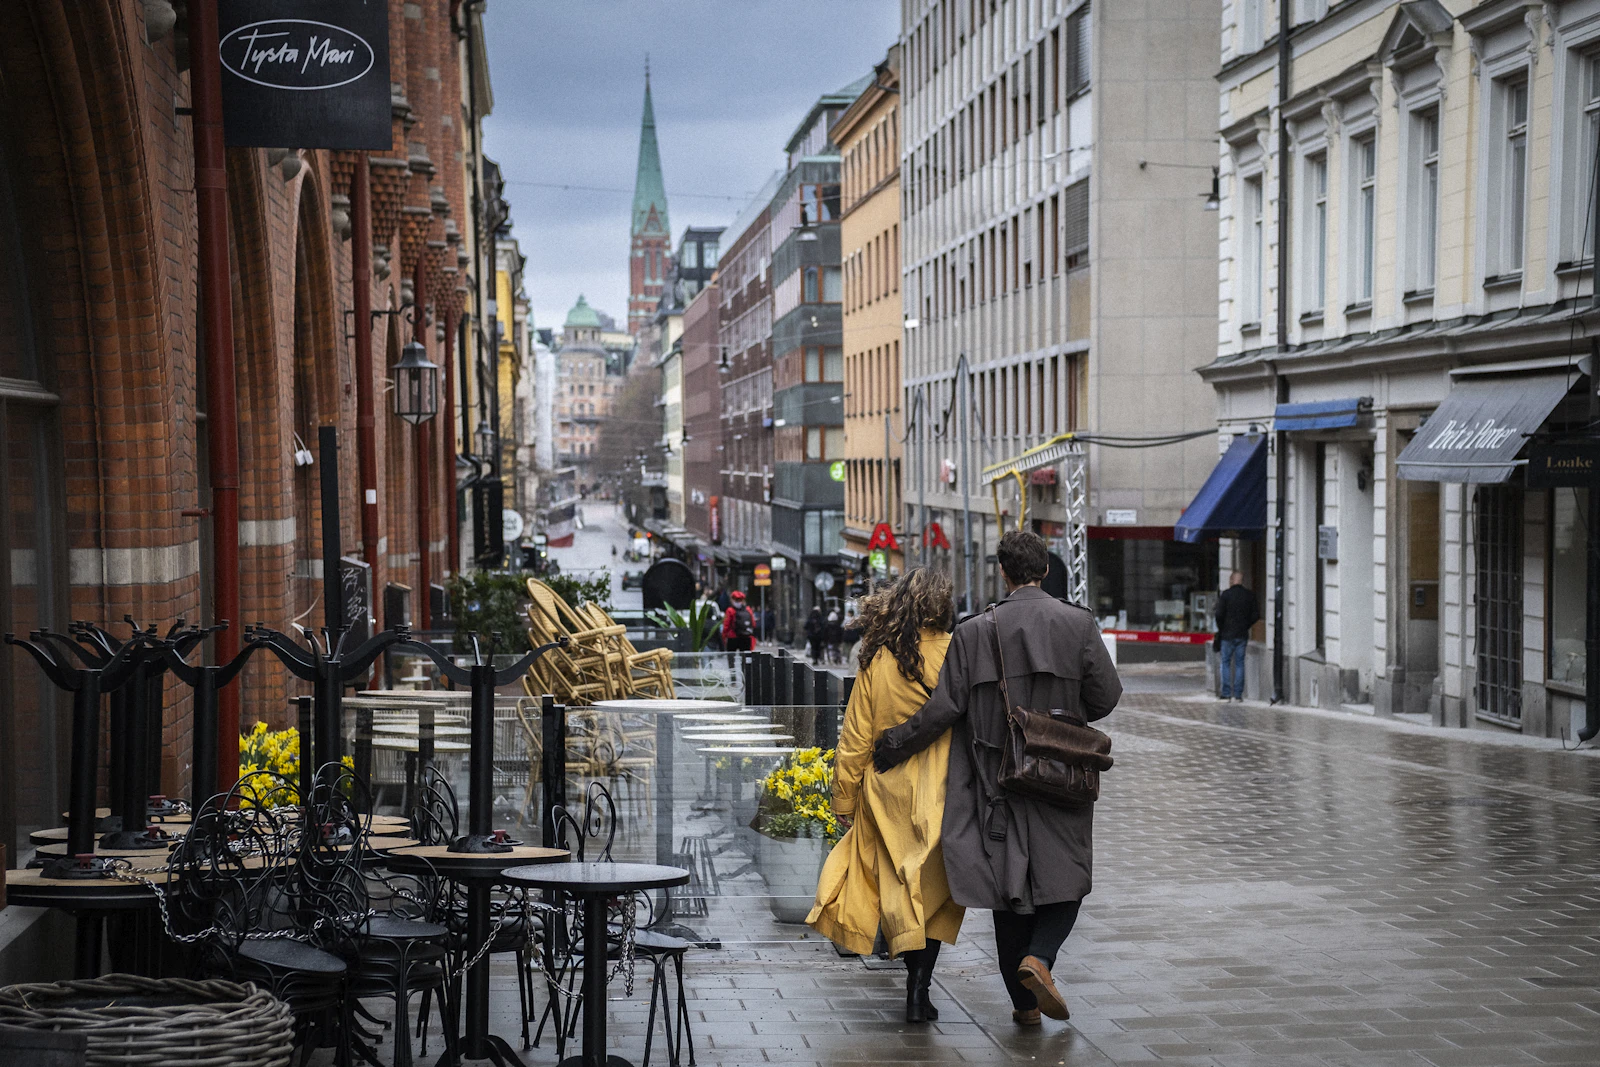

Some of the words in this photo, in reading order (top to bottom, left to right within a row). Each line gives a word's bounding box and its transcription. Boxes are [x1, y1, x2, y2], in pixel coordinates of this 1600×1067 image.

[238, 28, 299, 74] Tysta
[300, 35, 357, 74] Mari
[1464, 418, 1517, 449] Porter
[1546, 456, 1593, 468] Loake
